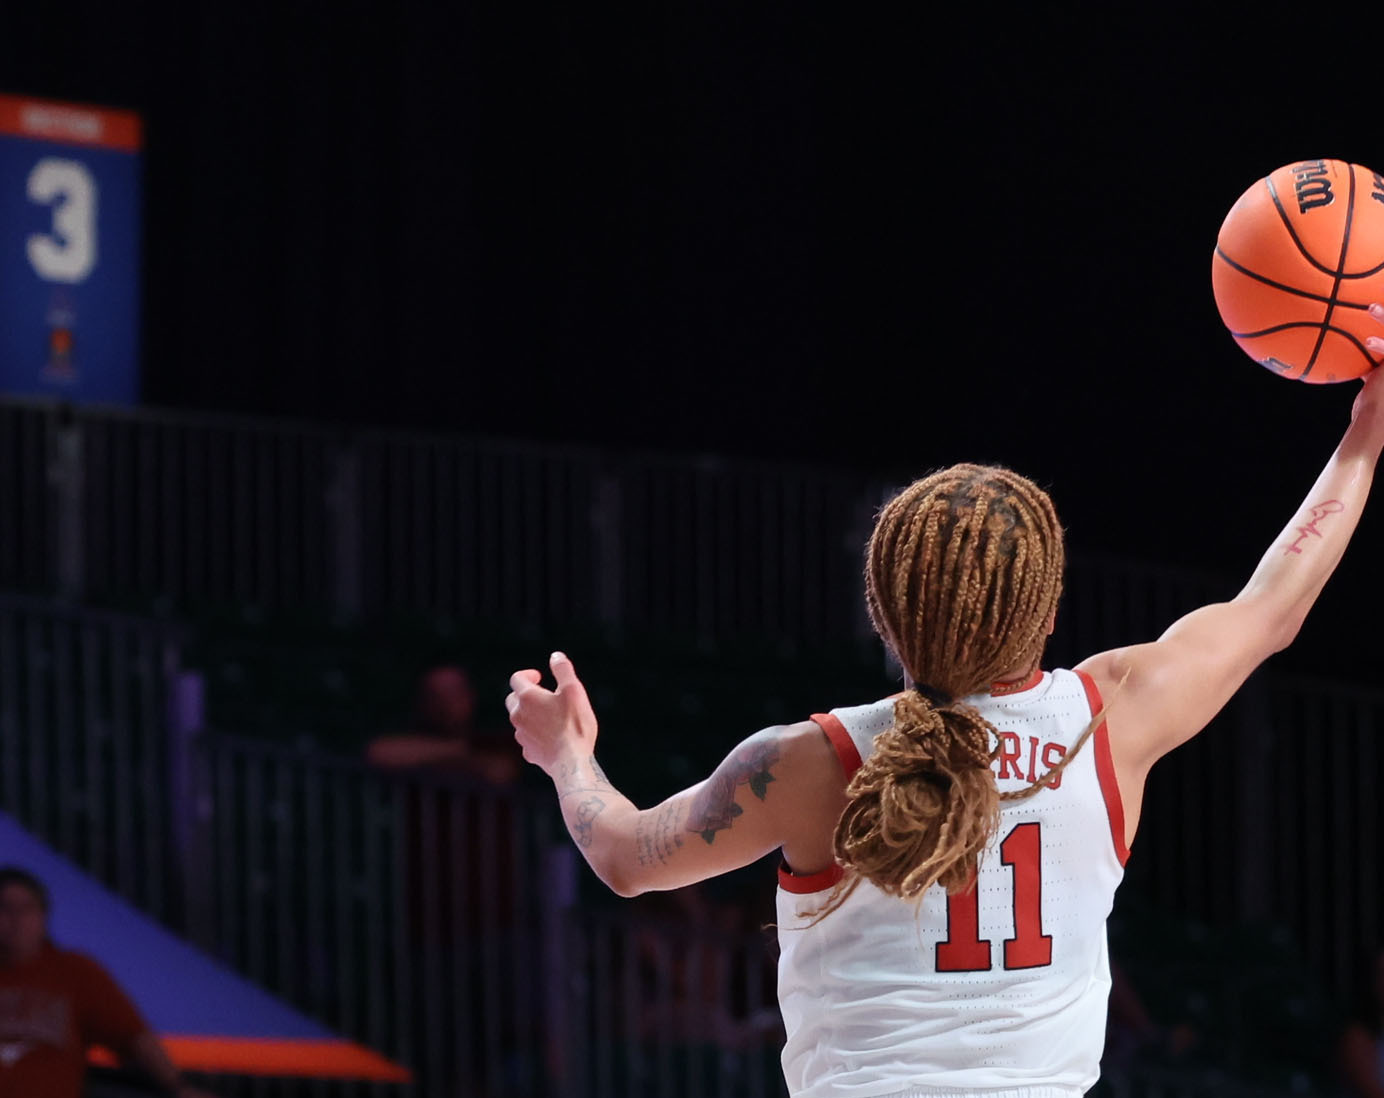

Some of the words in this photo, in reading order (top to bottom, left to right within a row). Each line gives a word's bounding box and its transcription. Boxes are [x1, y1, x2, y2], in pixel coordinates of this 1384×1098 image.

[26, 157, 98, 283] 3
[990, 731, 1067, 790] RIS
[935, 822, 1053, 973] 11
